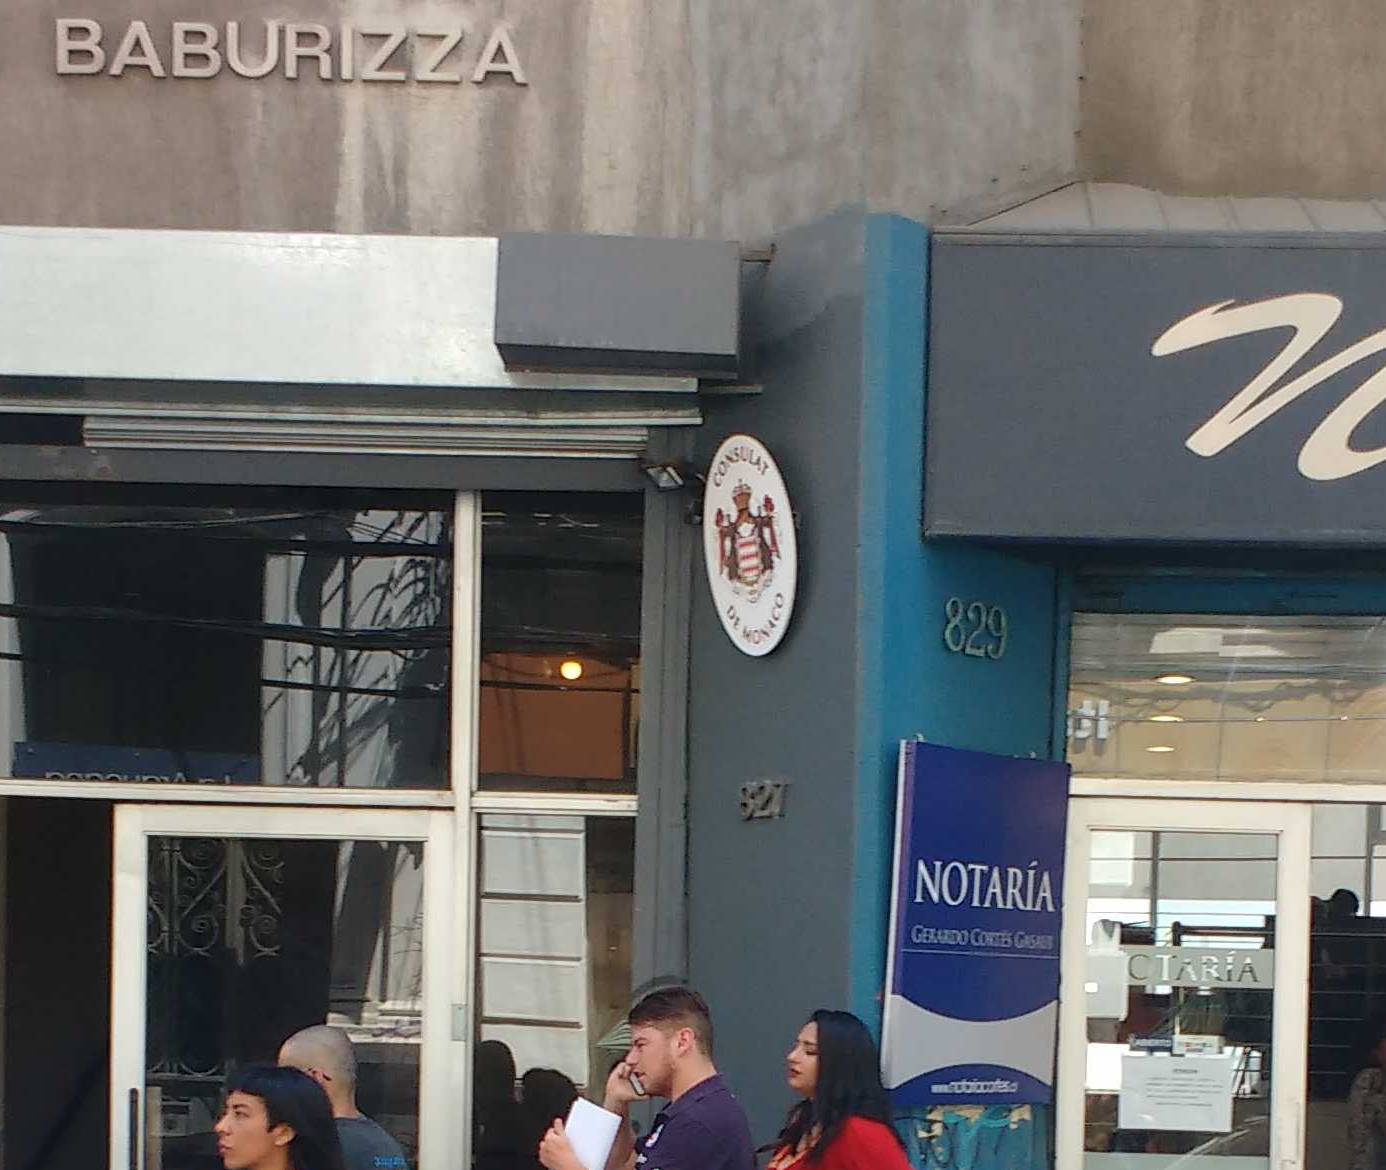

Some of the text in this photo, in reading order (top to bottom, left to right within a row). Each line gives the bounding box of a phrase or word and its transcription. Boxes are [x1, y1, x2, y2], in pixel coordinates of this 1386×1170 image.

[56, 18, 528, 84] BABURIZZA
[713, 446, 770, 488] CONSULAT
[742, 592, 785, 645] MONACO
[944, 597, 1007, 659] 829
[913, 859, 1056, 913] NOTARÍA
[911, 924, 969, 946] GERARDO
